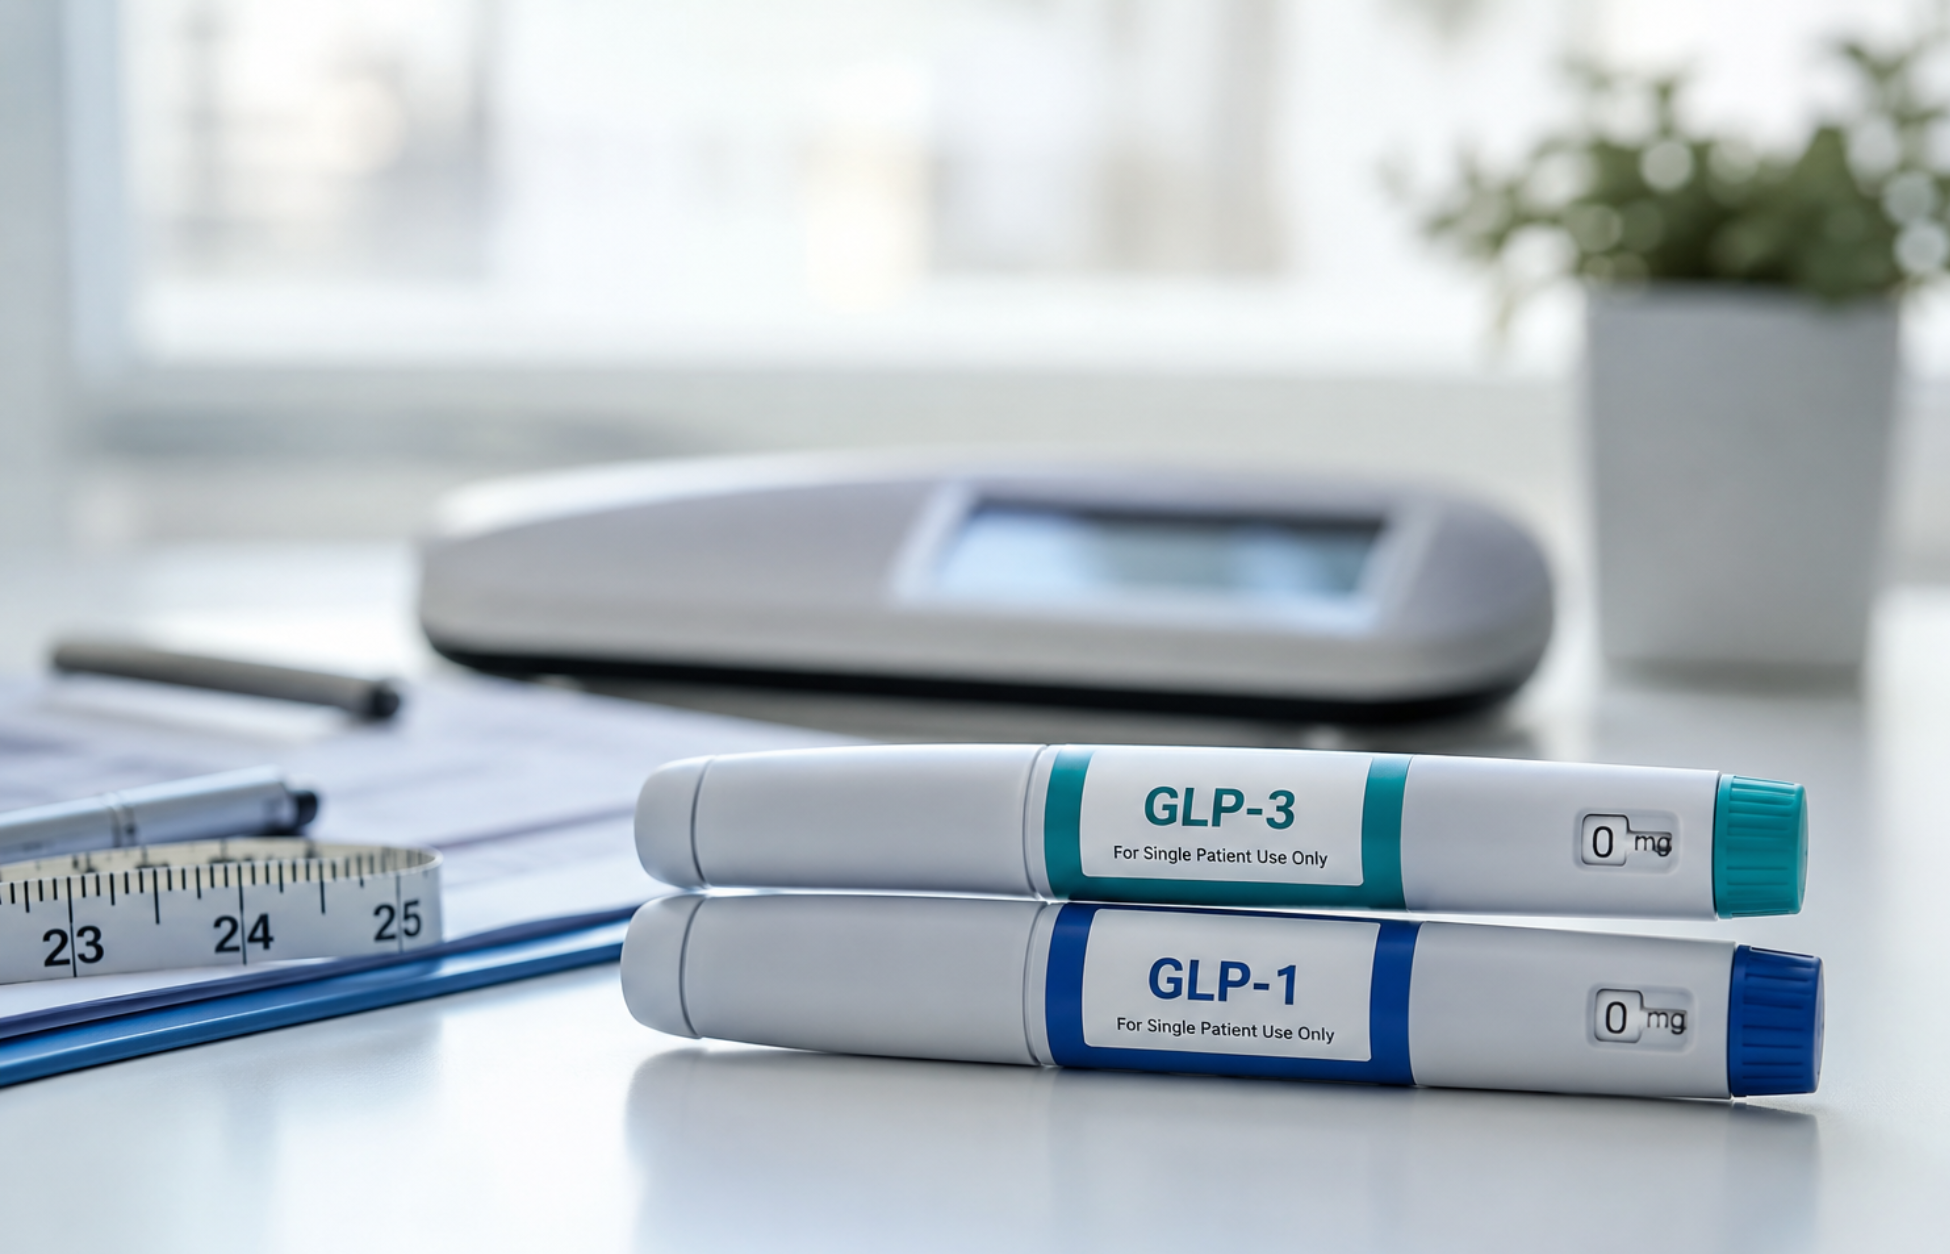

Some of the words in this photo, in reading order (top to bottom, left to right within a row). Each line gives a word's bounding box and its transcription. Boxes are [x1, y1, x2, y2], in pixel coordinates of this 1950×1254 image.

[1144, 786, 1296, 830] GLP-3
[1113, 845, 1139, 860] For
[1144, 846, 1192, 864] Single
[1196, 848, 1252, 863] Patient
[1257, 850, 1287, 865] Use
[1292, 851, 1328, 869] Only
[42, 925, 105, 967] 23
[213, 913, 275, 954] 24
[373, 900, 423, 942] 25
[1148, 957, 1297, 1006] GLP-1
[1116, 1017, 1142, 1032] For
[1147, 1019, 1196, 1037] Single
[1200, 1021, 1258, 1038] Patient
[1262, 1025, 1293, 1040] Use
[1298, 1026, 1335, 1045] Only
[1646, 1010, 1687, 1035] mg
